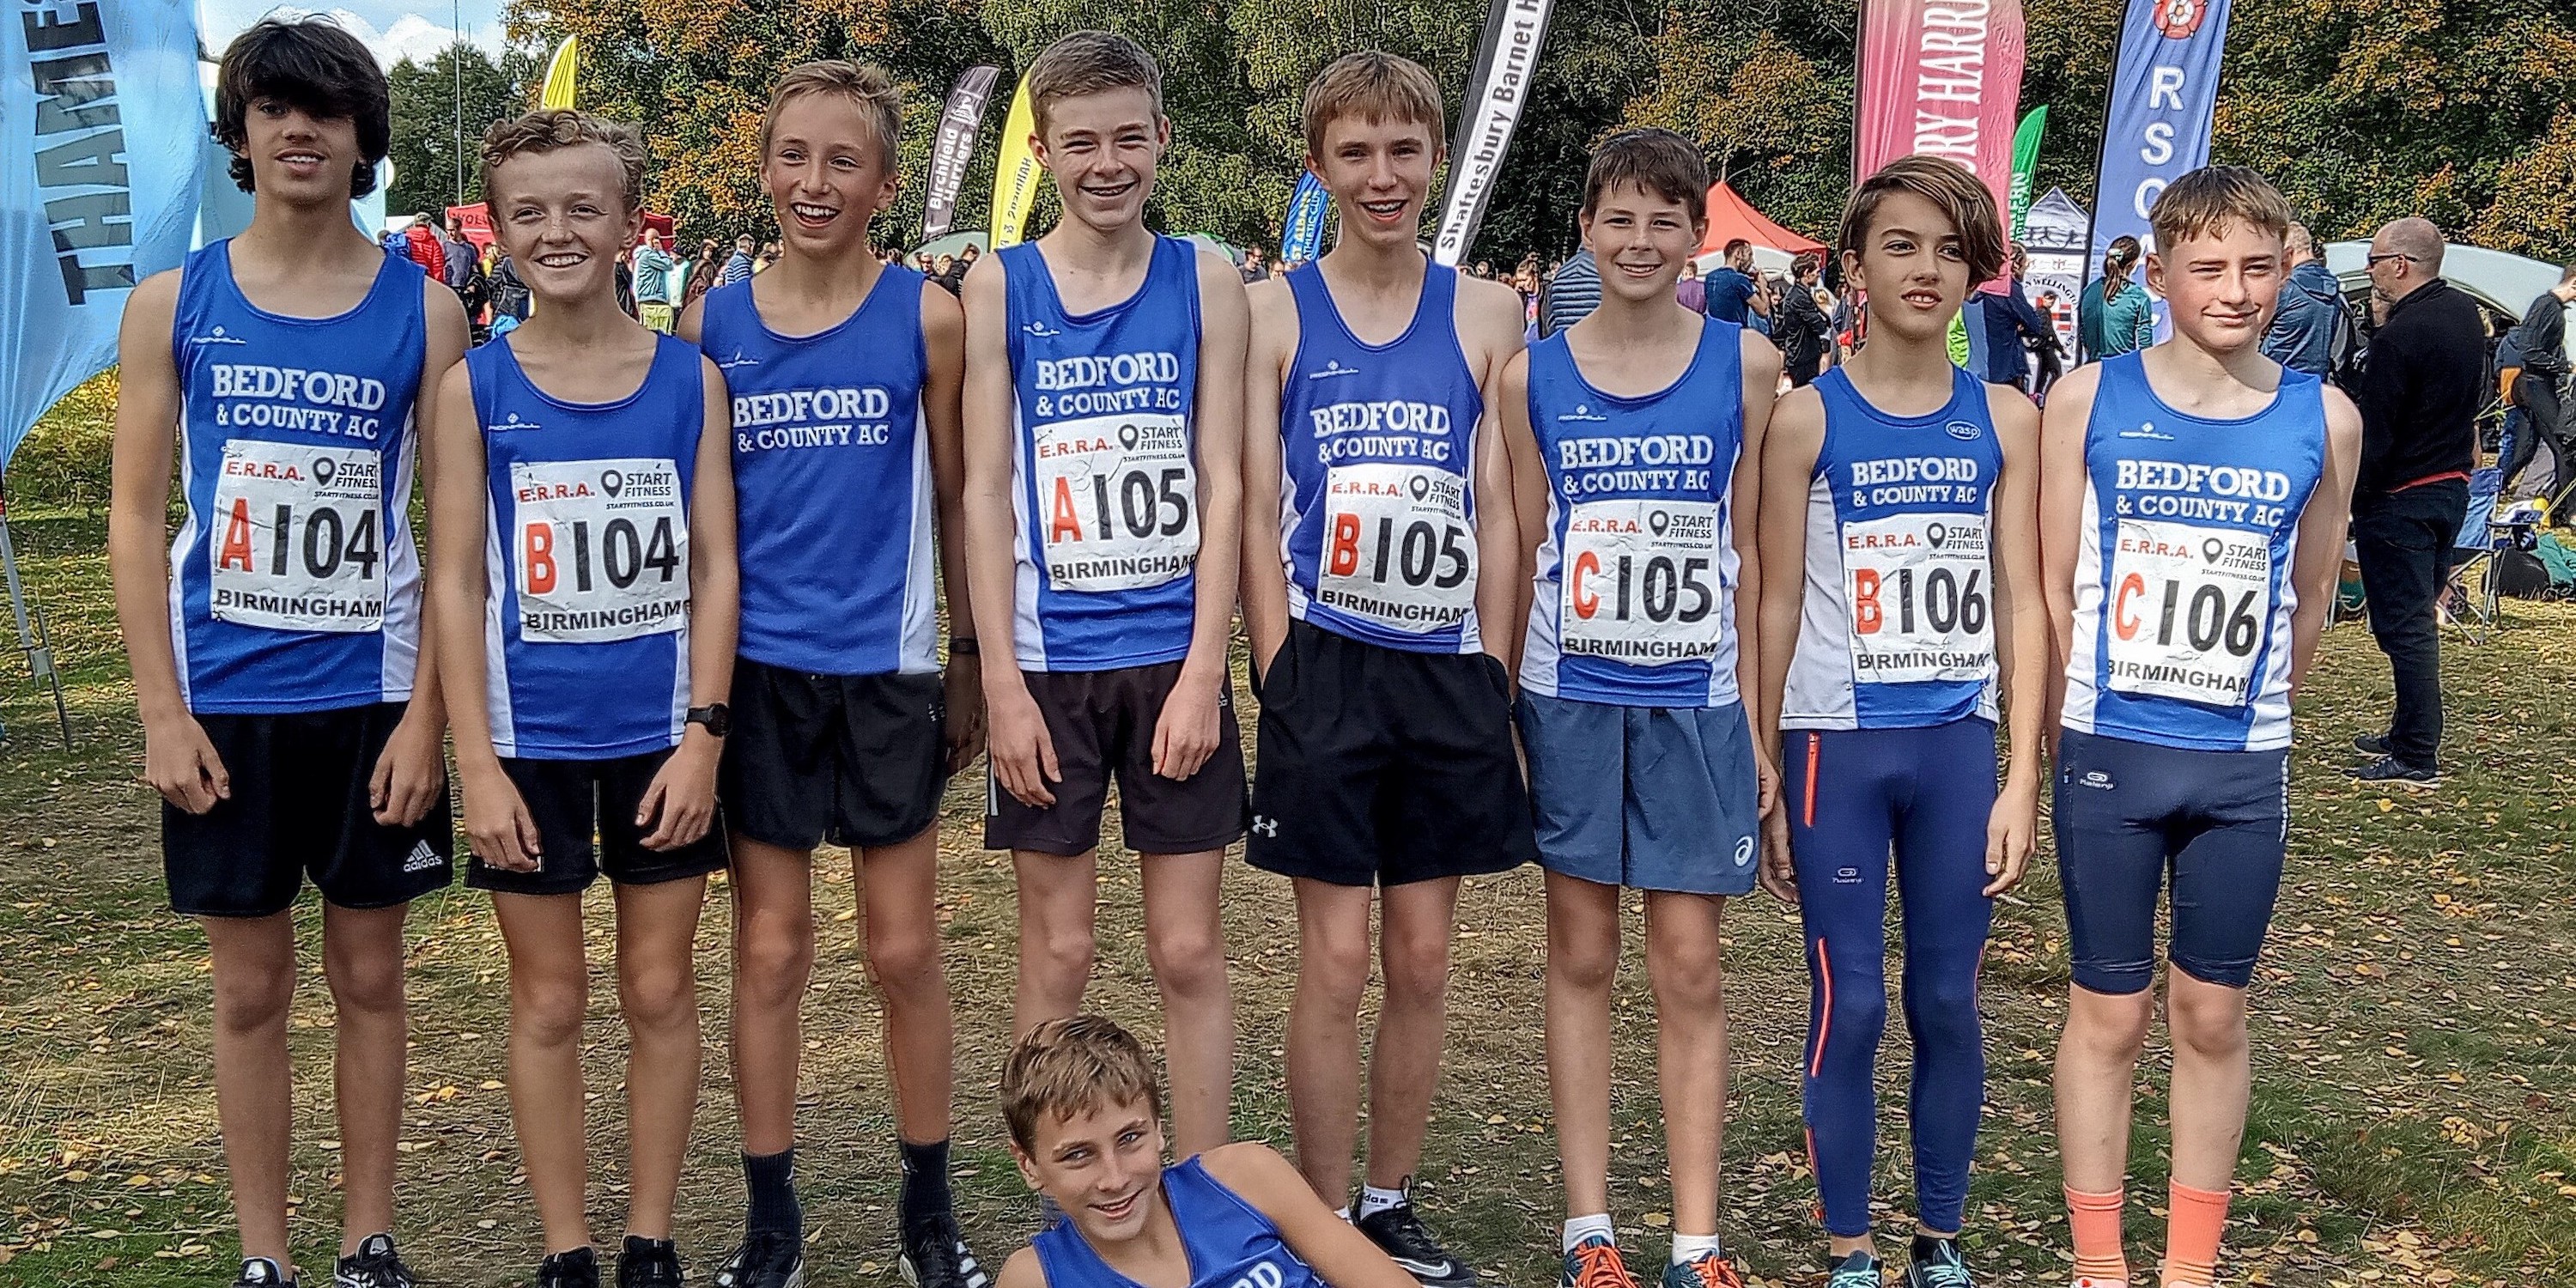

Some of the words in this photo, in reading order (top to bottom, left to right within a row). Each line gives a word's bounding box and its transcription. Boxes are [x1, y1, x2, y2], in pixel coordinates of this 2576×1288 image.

[1917, 0, 1991, 105] HARR
[1441, 110, 1512, 250] Shaftesbury
[1492, 20, 1535, 104] Barnet
[21, 0, 136, 306] THAME
[929, 129, 958, 210] Birchfield
[944, 132, 973, 203] Harriers
[1035, 352, 1179, 391] BEDFORD
[211, 364, 386, 410] BEDFORD
[733, 389, 890, 428] BEDFORD
[1036, 396, 1054, 416] &
[1059, 387, 1151, 414] COUNTY
[1155, 388, 1180, 409] AC
[216, 404, 228, 425] &
[233, 404, 343, 434] COUNTY
[344, 416, 380, 440] AC
[1310, 400, 1450, 439] BEDFORD
[738, 433, 755, 453] &
[757, 425, 853, 450] COUNTY
[856, 424, 889, 446] AC
[1141, 427, 1182, 440] START
[1039, 438, 1114, 459] E.R.R.A.
[1140, 439, 1182, 451] FITNESS
[1318, 443, 1332, 463] &
[1333, 436, 1418, 459] COUNTY
[1422, 440, 1450, 461] AC
[1558, 435, 1713, 470] BEDFORD
[226, 461, 305, 481] E.R.R.A.
[625, 473, 672, 485] START
[1851, 457, 1978, 486] BEDFORD
[2116, 459, 2290, 502] BEDFORD
[624, 487, 671, 498] FITNESS
[1332, 483, 1403, 498] E.R.R.A.
[1431, 480, 1461, 501] START
[1563, 476, 1579, 494] &
[1582, 470, 1676, 491] COUNTY
[1683, 470, 1710, 490] AC
[519, 483, 596, 503] E.R.R.A.
[1429, 493, 1460, 511] FITNESS
[1853, 490, 1868, 507] &
[1872, 486, 1950, 504] COUNTY
[1955, 486, 1977, 502] AC
[606, 501, 675, 510] STARTFITNESS.CO.UK
[2116, 495, 2134, 515] &
[2139, 495, 2249, 524] COUNTY
[2251, 504, 2286, 528] AC
[1571, 519, 1643, 533] E.R.R.A.
[1673, 515, 1714, 529] START
[1668, 527, 1712, 539] FITNESS
[1848, 534, 1923, 549] E.R.R.A.
[1948, 527, 1983, 540] START
[1946, 539, 1984, 550] FITNESS
[2120, 538, 2193, 559] E.R.R.A.
[2222, 557, 2266, 571] FITNESS
[216, 588, 381, 617] BIRMINGHAM
[1321, 590, 1467, 623] BIRMINGHAM
[526, 600, 682, 630] BIRMINGHAM
[1564, 638, 1717, 658] BIRMINGHAM
[403, 856, 443, 872] adidas
